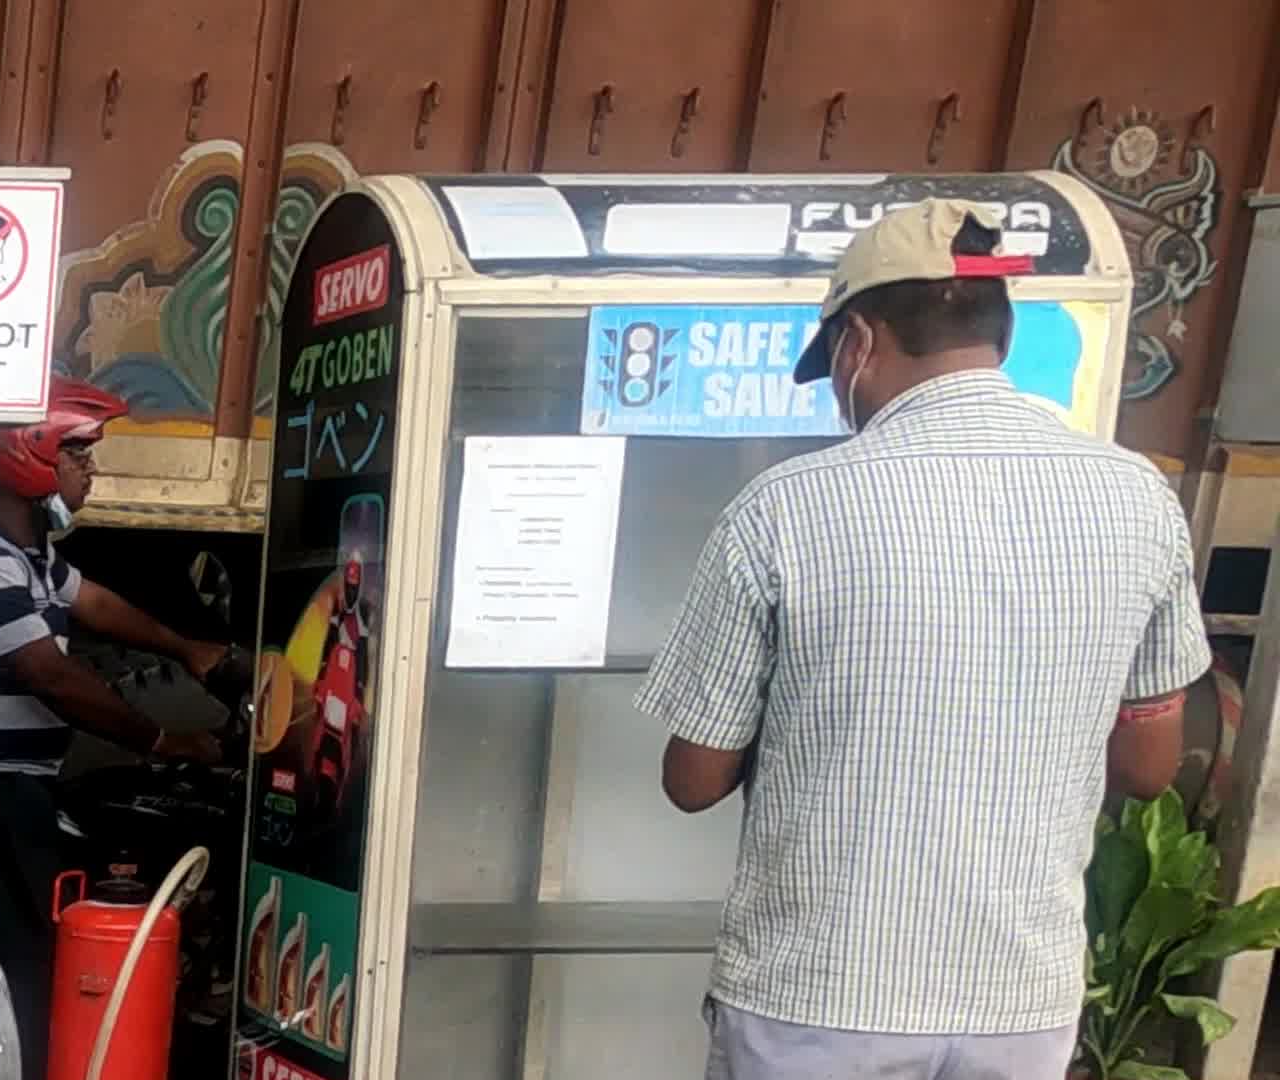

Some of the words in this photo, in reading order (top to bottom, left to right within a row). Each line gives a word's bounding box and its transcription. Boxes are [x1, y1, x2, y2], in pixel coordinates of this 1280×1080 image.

[318, 257, 383, 316] SERVO
[322, 325, 393, 388] GOBEN
[689, 321, 790, 367] SAFE
